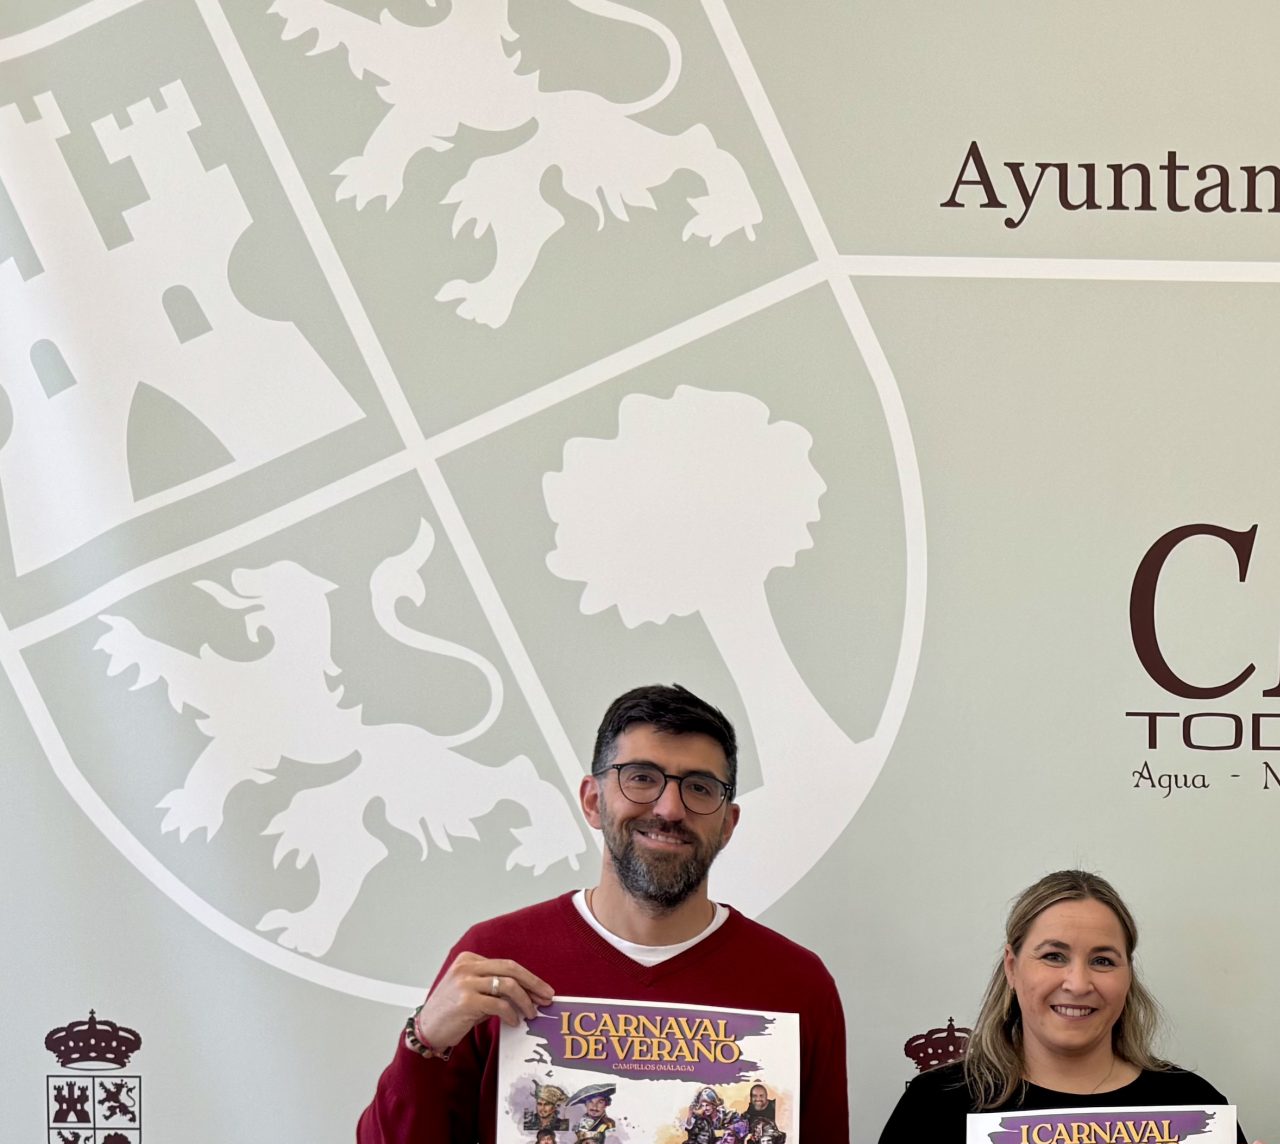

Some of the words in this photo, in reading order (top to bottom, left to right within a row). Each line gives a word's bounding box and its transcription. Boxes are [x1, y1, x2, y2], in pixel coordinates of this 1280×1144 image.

[1132, 760, 1210, 799] Agua
[560, 1011, 570, 1034] I
[573, 1013, 734, 1041] CARNAVAL
[563, 1035, 607, 1059] DE
[609, 1037, 740, 1062] VERANO
[656, 1063, 693, 1071] (MÁLAGA)
[1020, 1125, 1028, 1144] I
[1032, 1119, 1178, 1144] CARNAVAL
